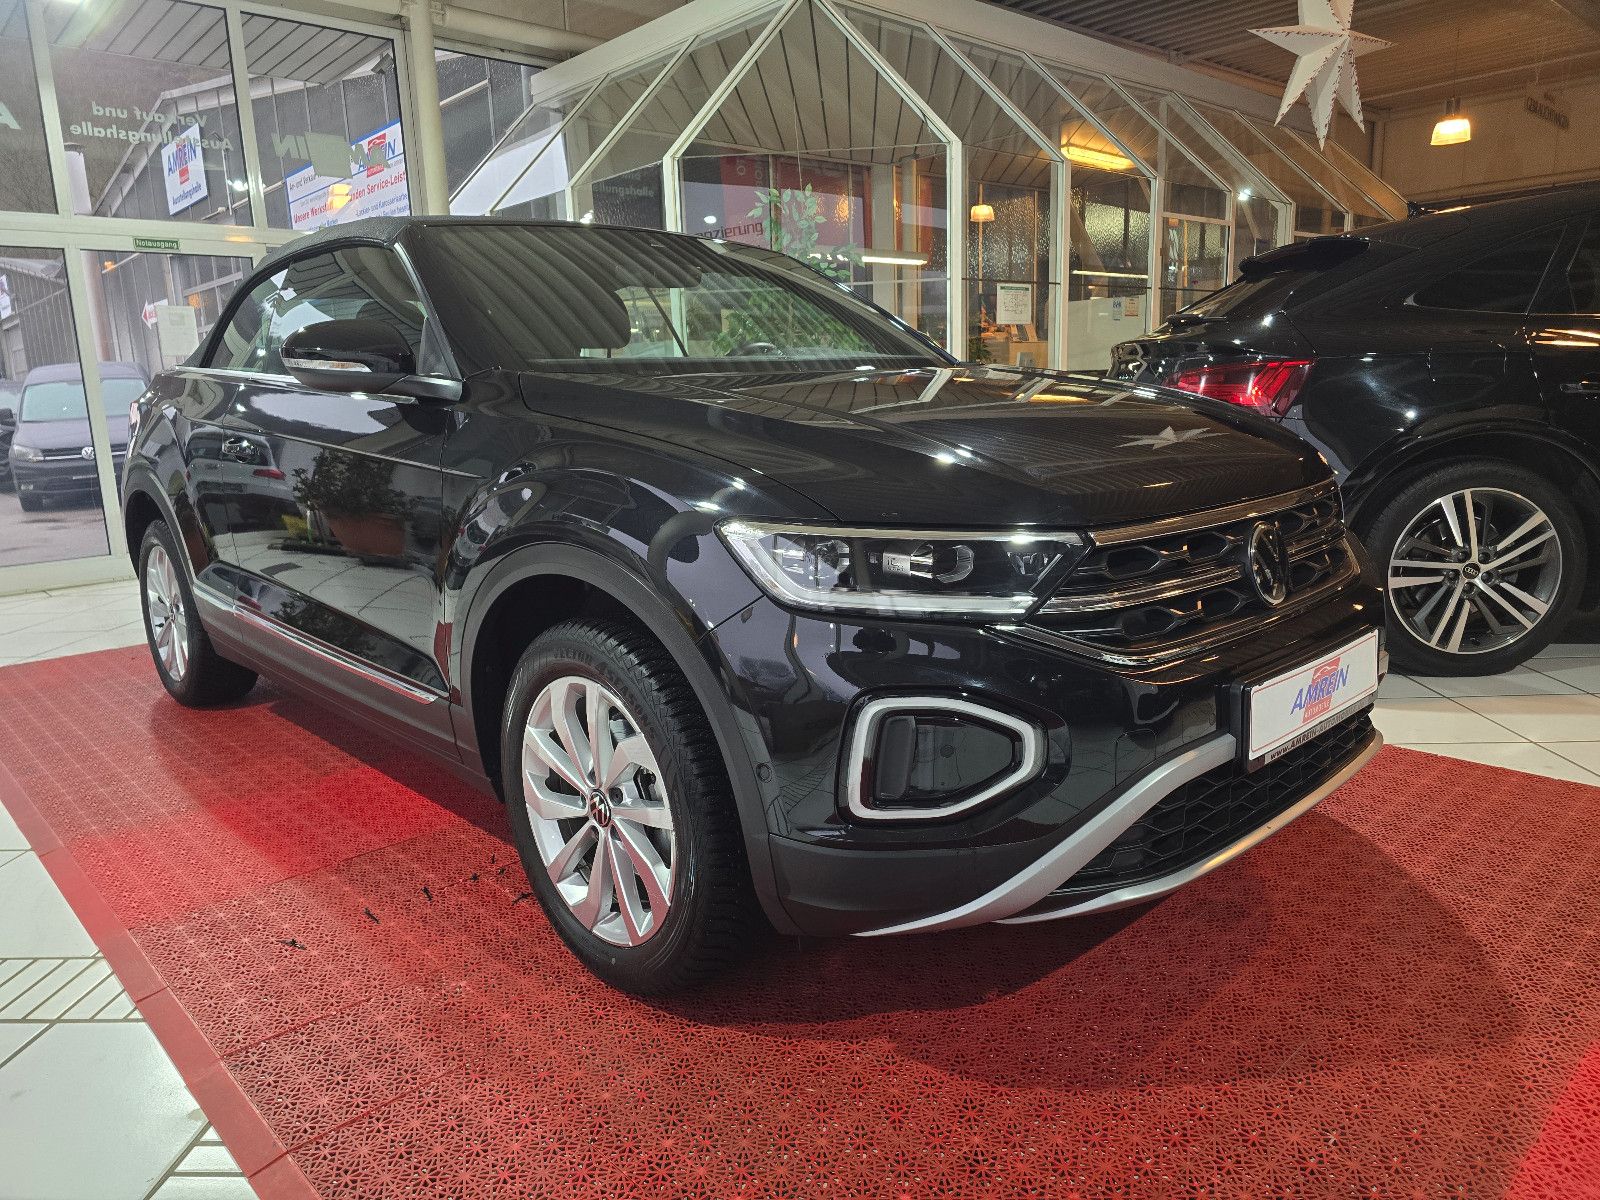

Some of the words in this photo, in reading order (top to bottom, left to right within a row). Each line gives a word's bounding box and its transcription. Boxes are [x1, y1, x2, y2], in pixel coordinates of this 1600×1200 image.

[168, 138, 197, 177] AMREIN
[136, 239, 178, 249] Notausgang
[1290, 664, 1350, 716] AMREIN
